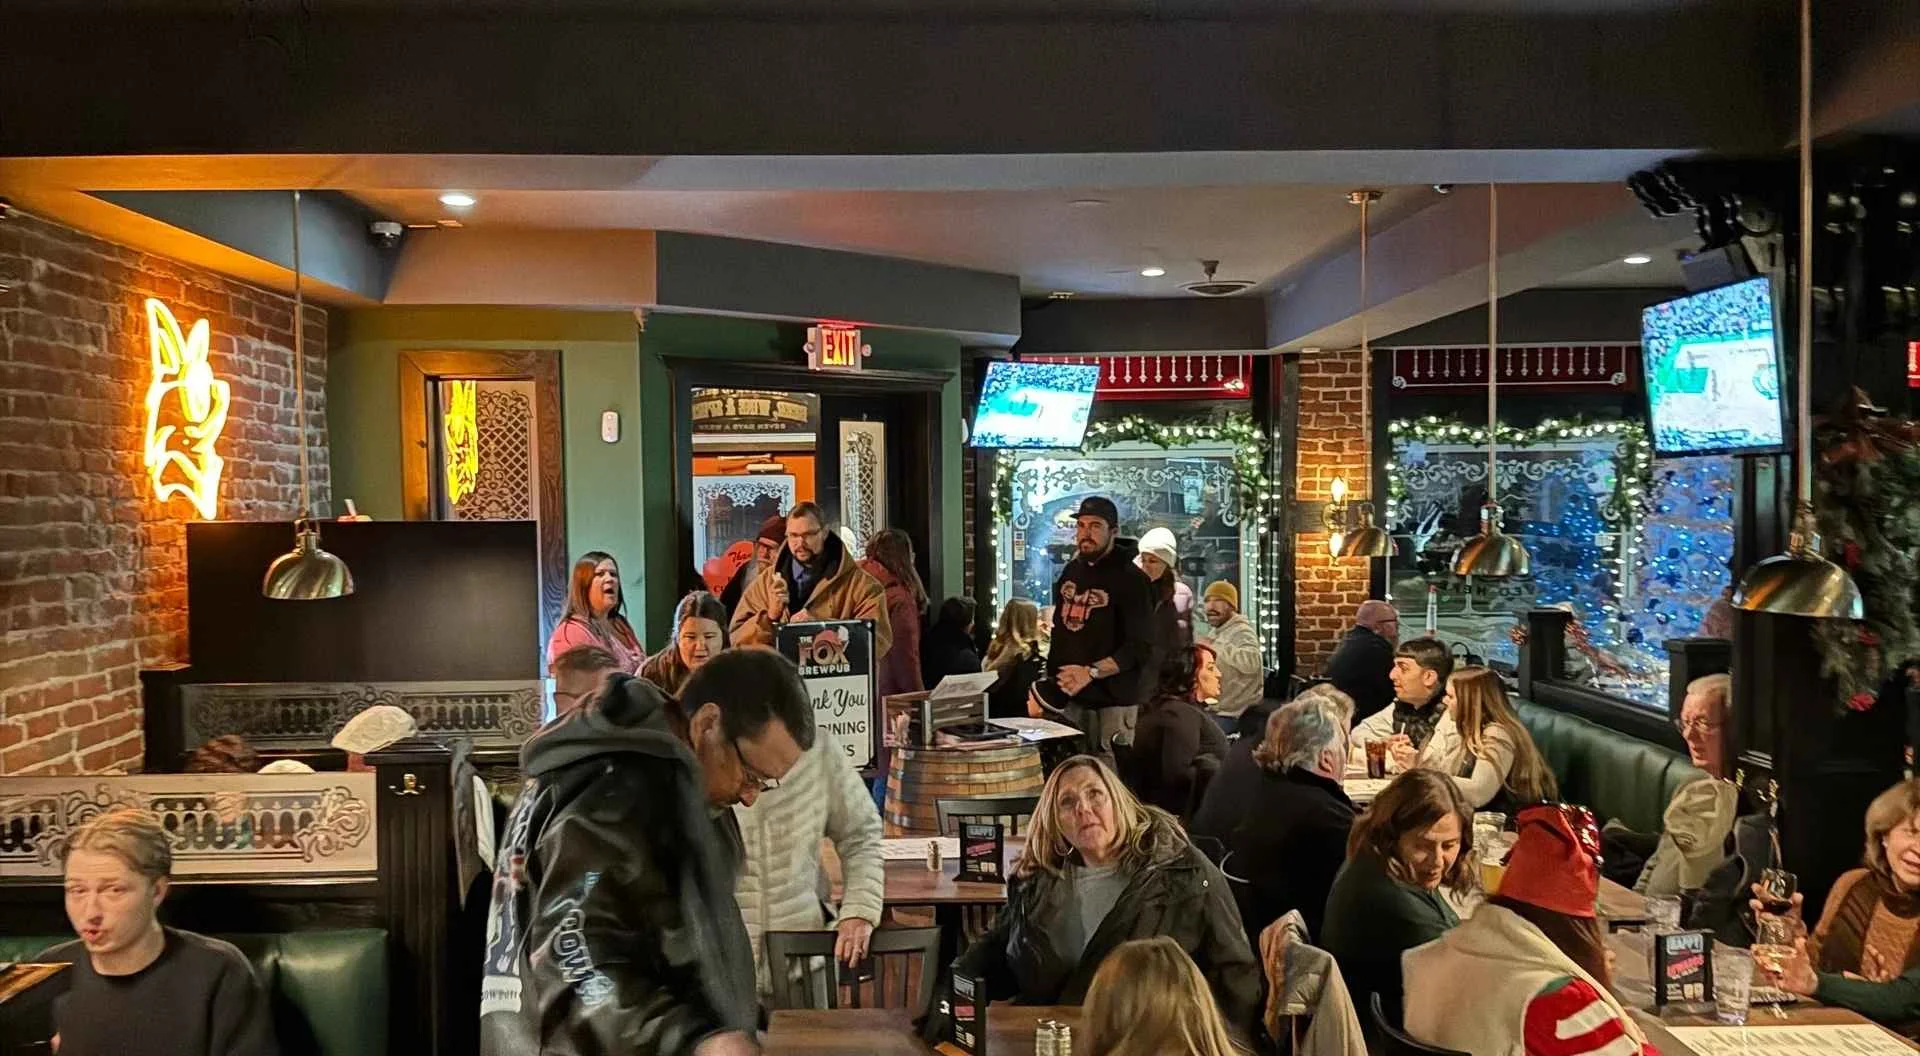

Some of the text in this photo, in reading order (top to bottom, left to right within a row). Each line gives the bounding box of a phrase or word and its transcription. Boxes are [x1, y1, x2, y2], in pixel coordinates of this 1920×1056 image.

[822, 329, 856, 365] EXIT
[799, 635, 812, 644] THE
[798, 637, 849, 666] FOX
[798, 663, 850, 676] BREWPUB
[833, 688, 867, 717] You
[818, 721, 866, 735] INING
